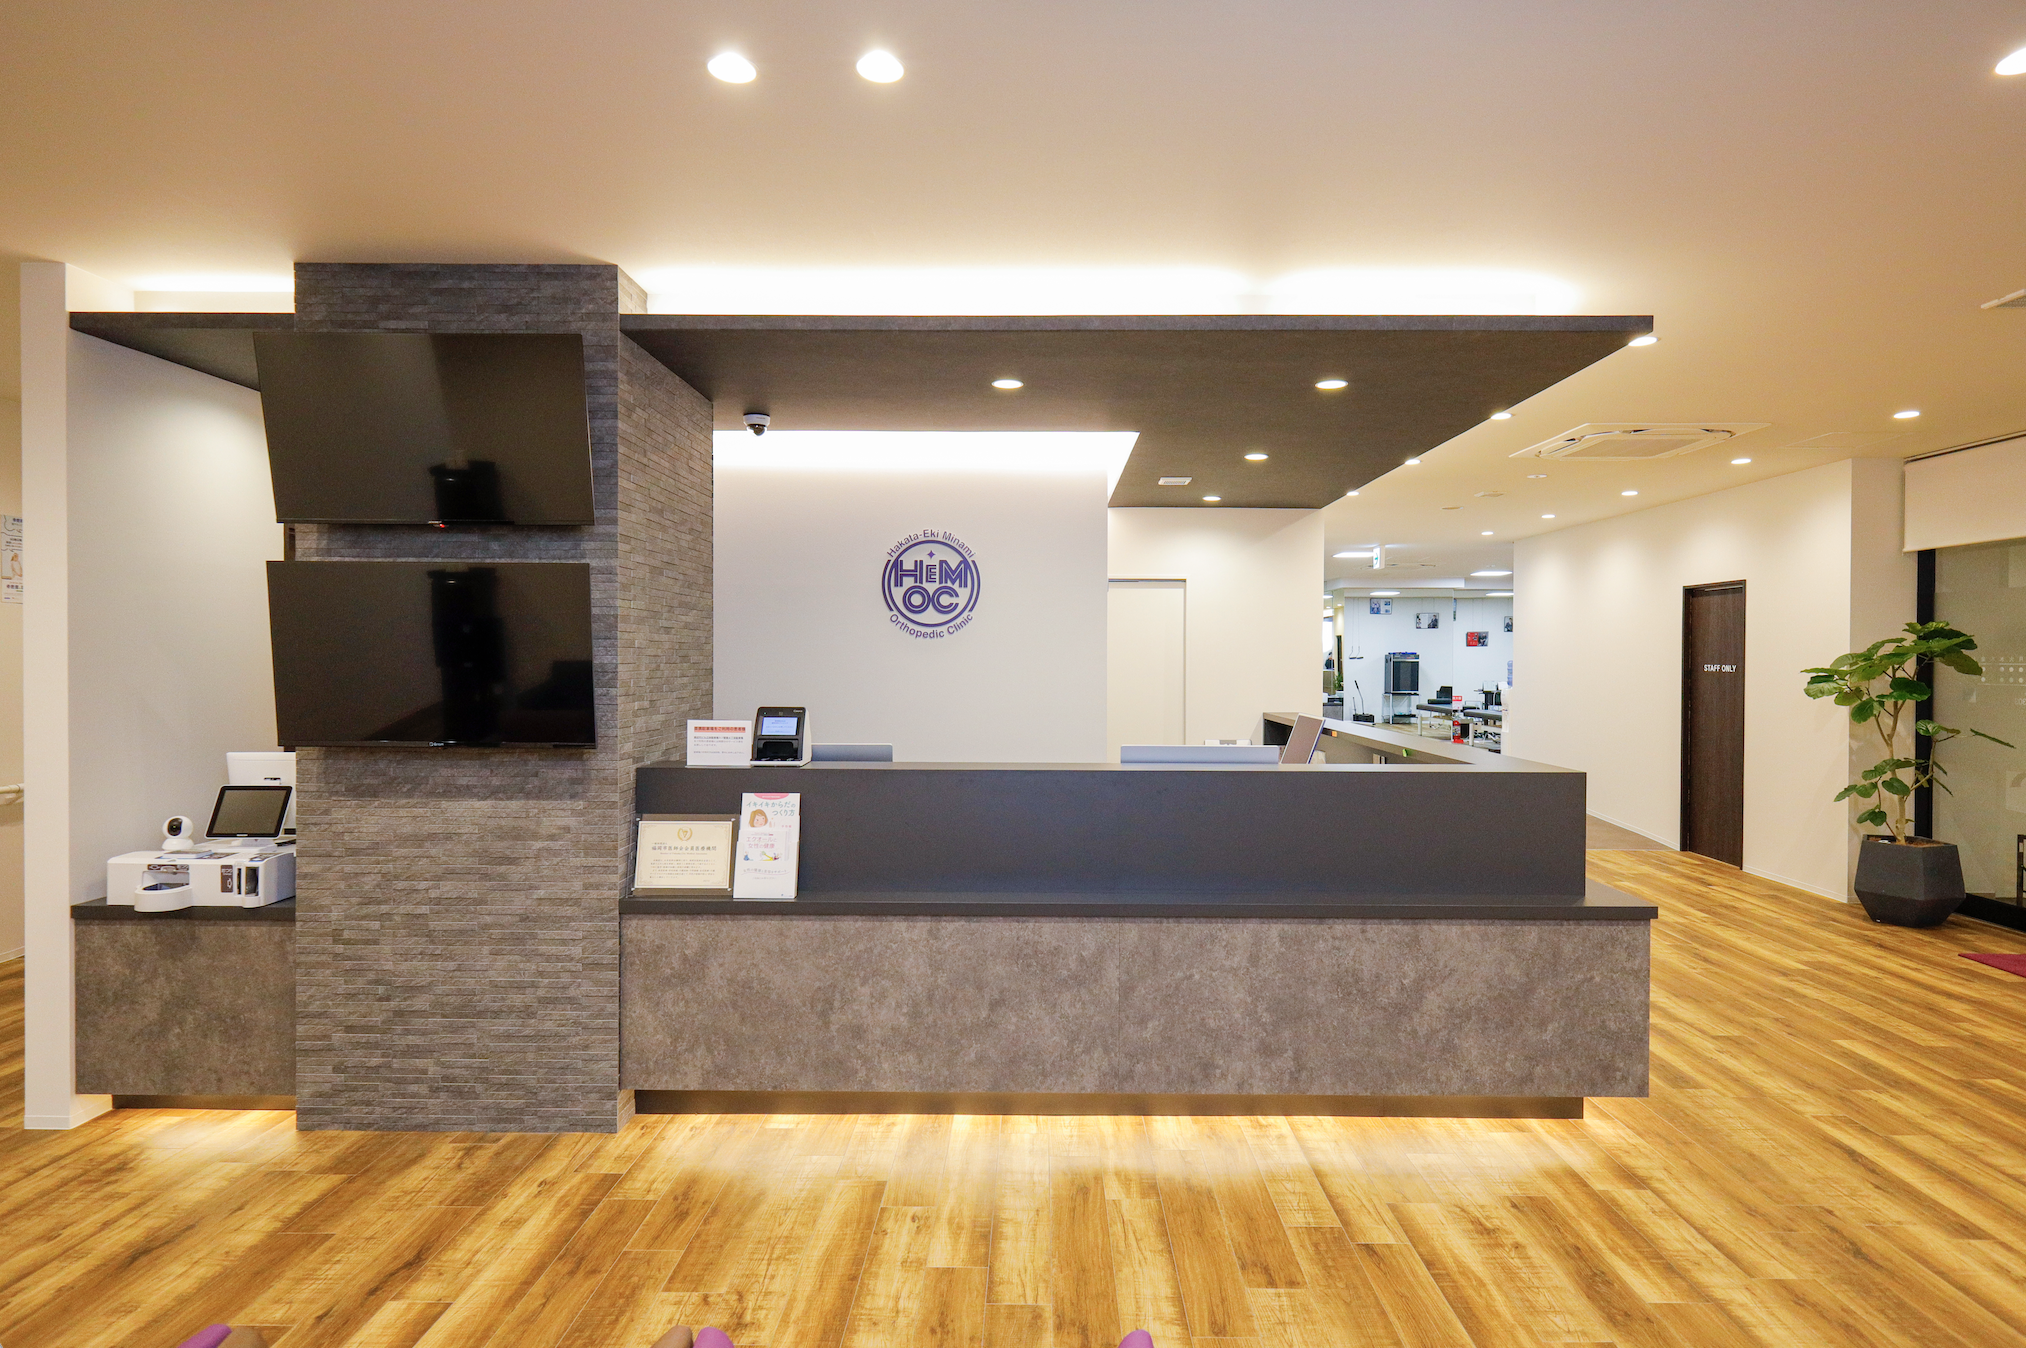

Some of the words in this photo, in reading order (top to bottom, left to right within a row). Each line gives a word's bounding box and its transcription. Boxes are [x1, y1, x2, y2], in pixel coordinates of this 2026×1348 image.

[886, 529, 939, 558] Hakata-Eki
[942, 531, 976, 558] Minami
[902, 585, 960, 614] OC
[889, 614, 945, 639] Orthopedic
[947, 614, 973, 635] Clinic
[1703, 664, 1720, 672] STAFF
[1721, 664, 1737, 673] ONLY
[772, 809, 795, 817] つくり方
